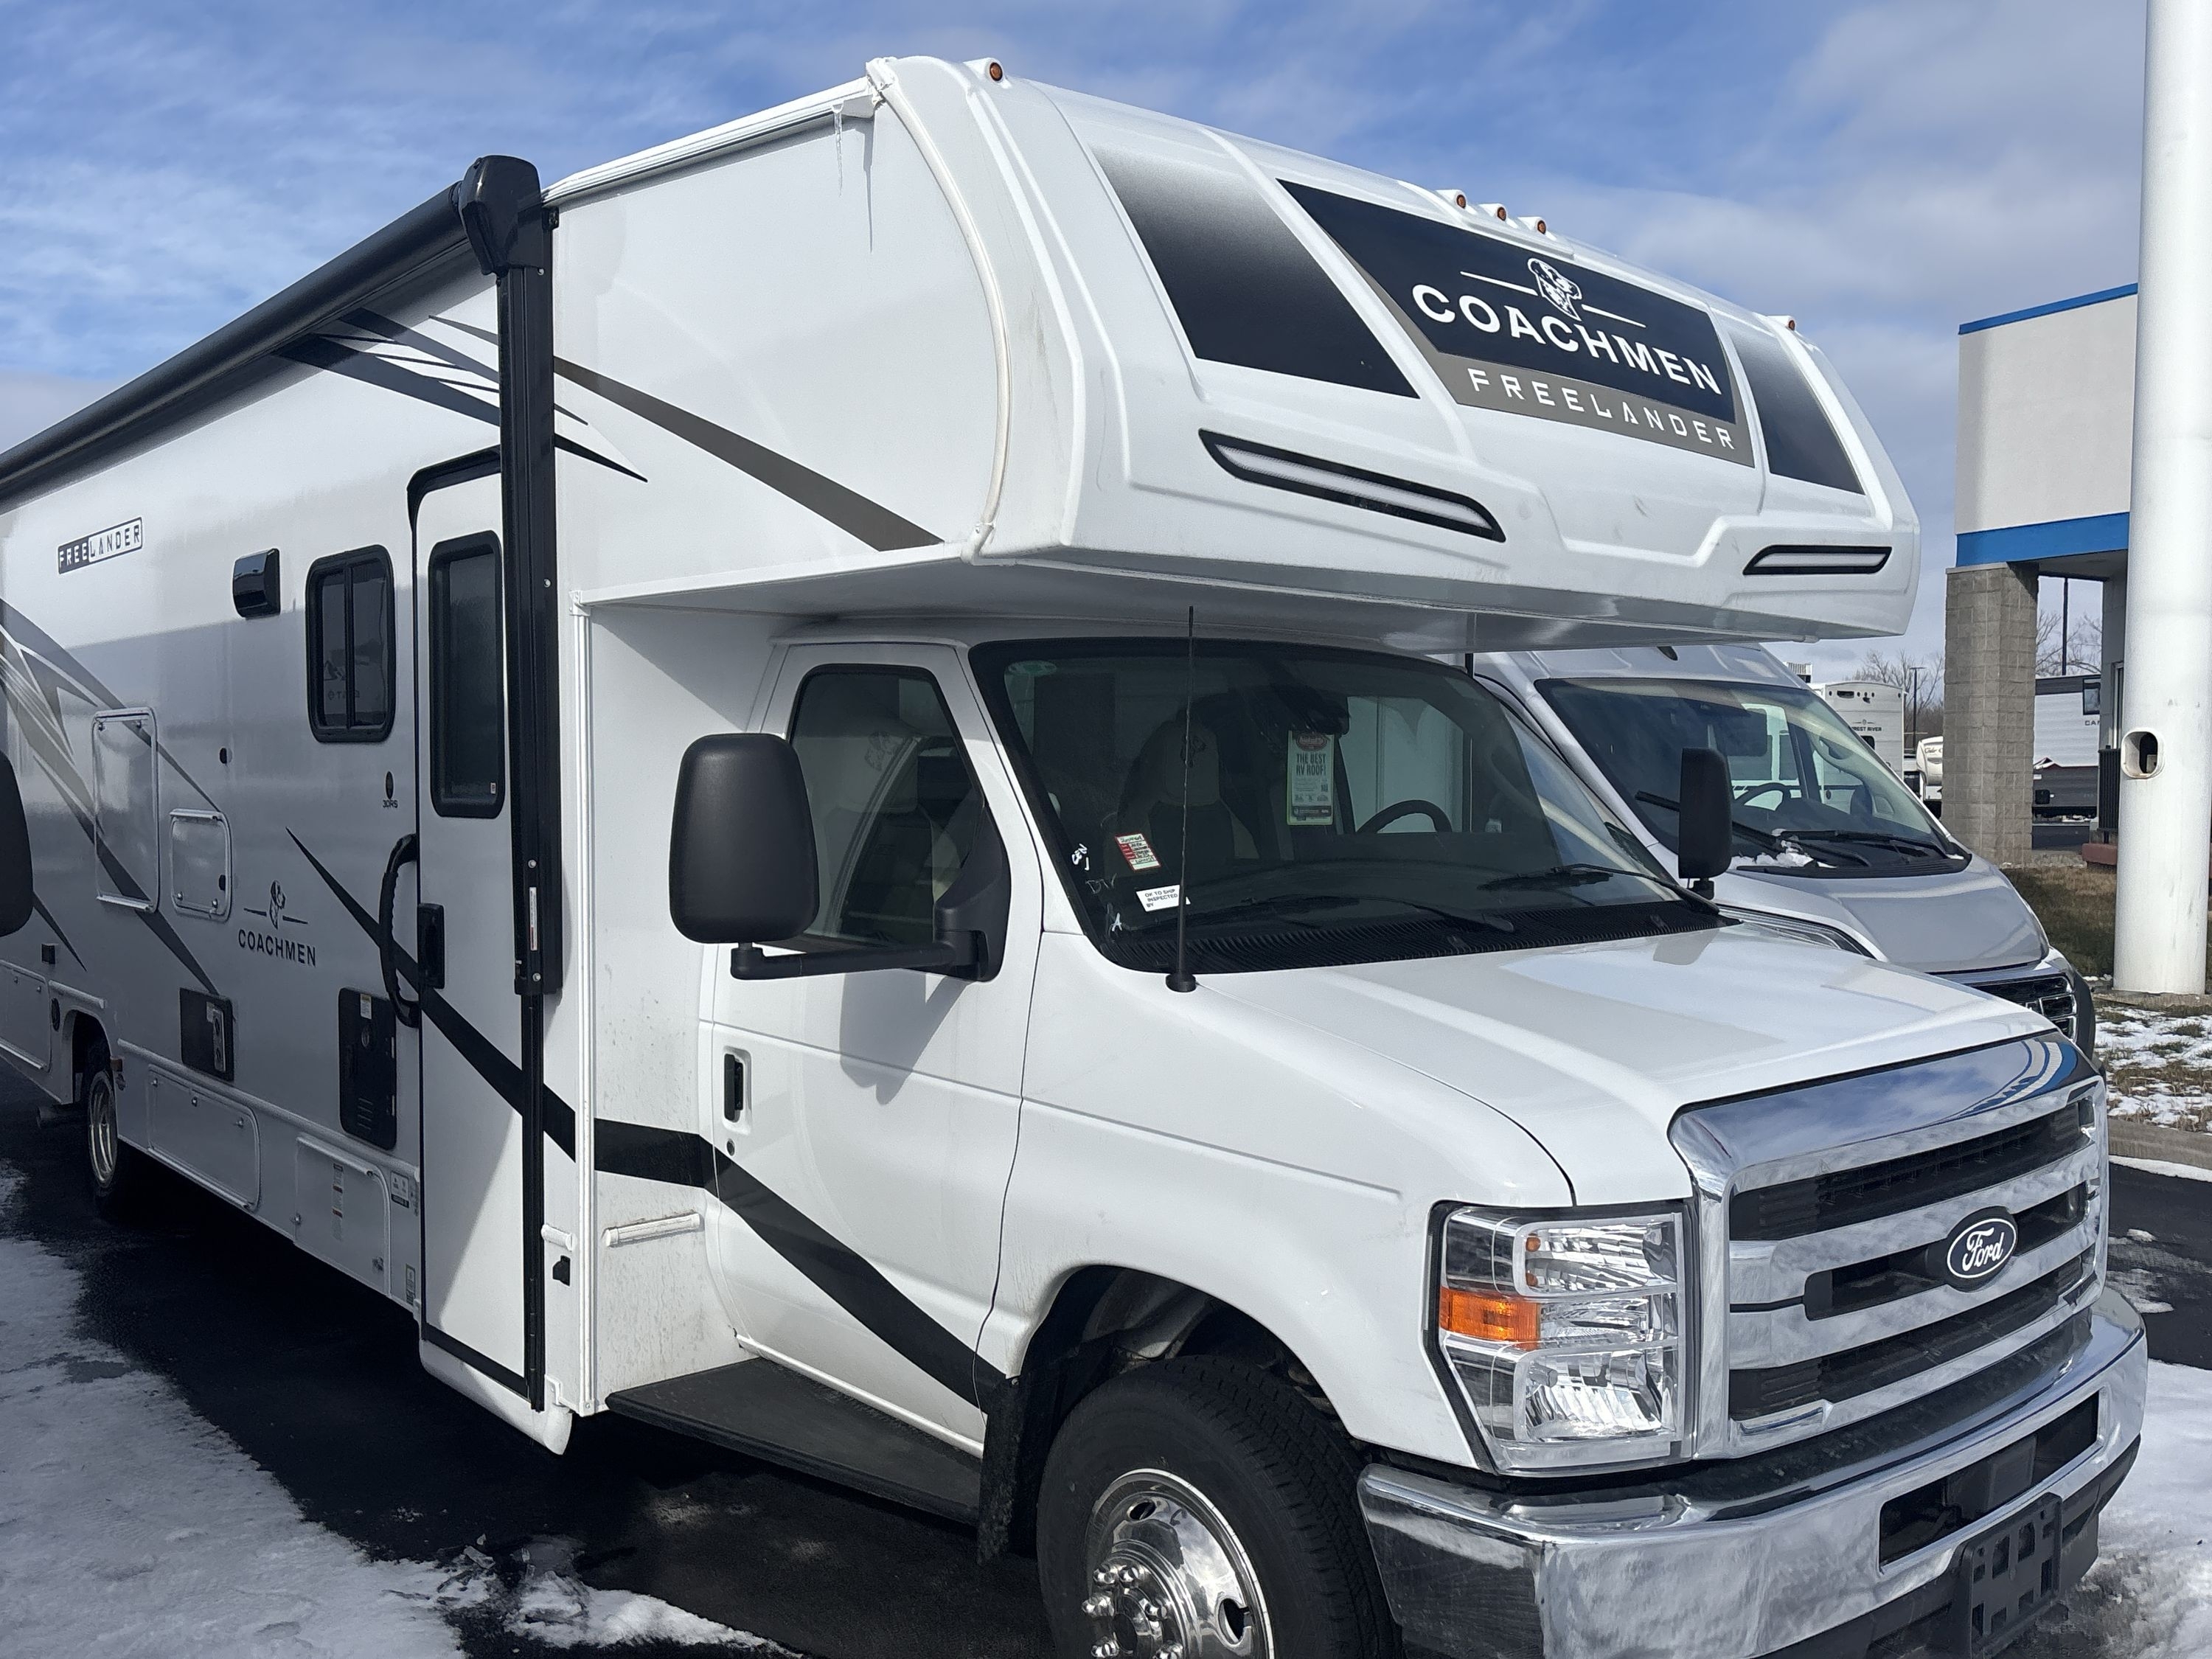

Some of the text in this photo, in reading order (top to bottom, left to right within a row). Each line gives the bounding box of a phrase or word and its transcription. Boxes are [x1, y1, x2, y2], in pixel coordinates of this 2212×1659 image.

[1412, 284, 1722, 395] COACHMEN
[1467, 368, 1735, 451] FREELANDER
[59, 524, 140, 569] FREELANDER
[1296, 765, 1305, 776] RV
[1297, 752, 1326, 765] THE BEST
[1147, 894, 1178, 902] INSPECTED
[238, 929, 316, 967] COACHMEN
[1962, 1227, 2005, 1272] Ford
